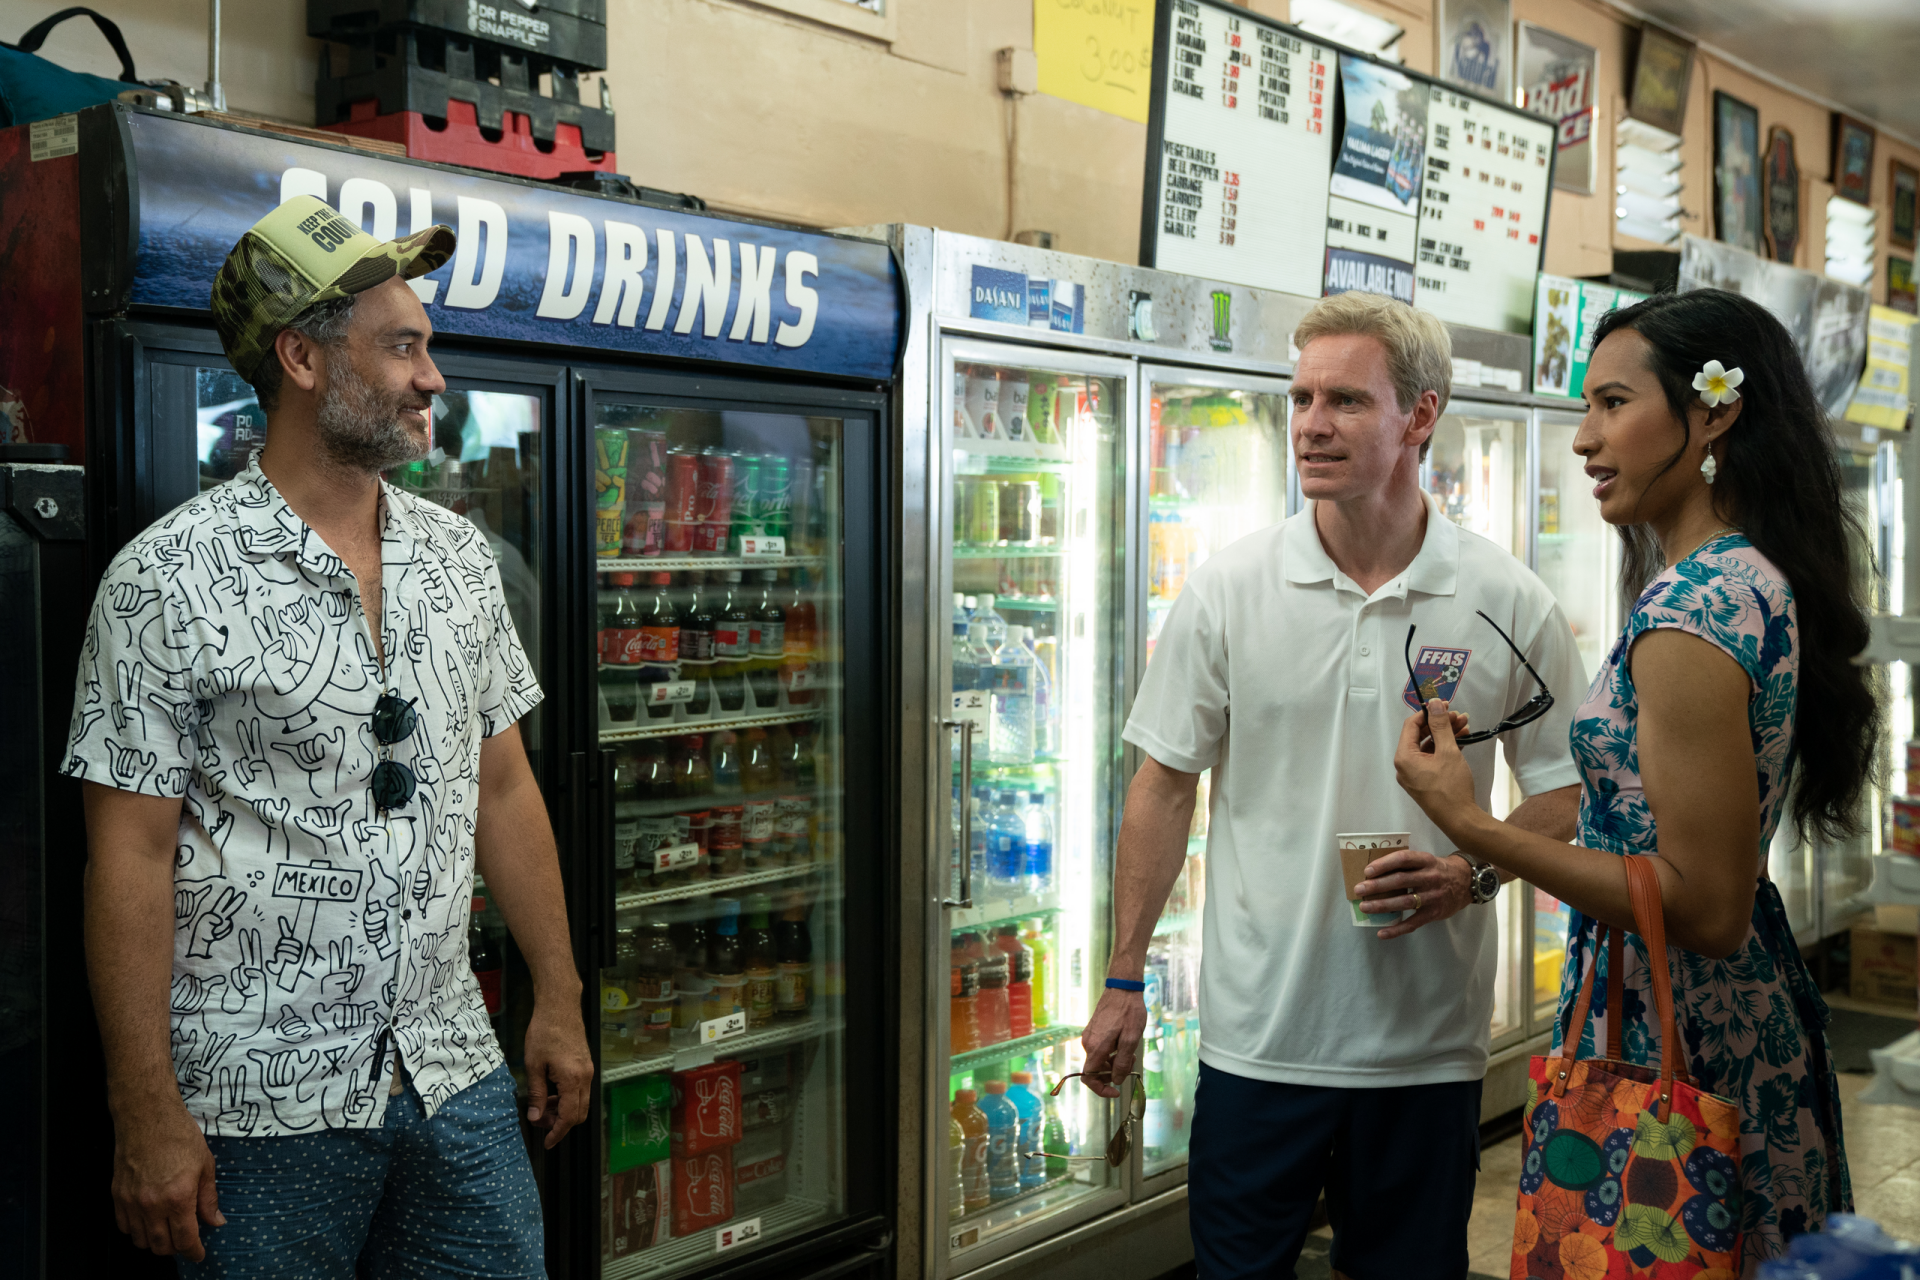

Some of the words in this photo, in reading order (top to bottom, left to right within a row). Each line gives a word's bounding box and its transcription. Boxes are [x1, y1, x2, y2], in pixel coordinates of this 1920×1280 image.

[478, 4, 497, 21] DR
[500, 10, 550, 35] PEPPER
[1178, 15, 1203, 36] APPLE
[478, 20, 538, 46] SNAPPLE
[1256, 26, 1301, 54] VEGETABLES
[1172, 78, 1204, 100] ORANGE
[1527, 64, 1588, 119] Bud
[1163, 140, 1215, 166] VEGETABLES
[1168, 157, 1187, 175] BELL
[1190, 163, 1219, 182] PEPPER
[1166, 173, 1203, 194] CABBAGE
[1165, 188, 1202, 209] CARROTS
[296, 215, 321, 236] KEEP
[1164, 204, 1197, 223] CELERY
[1164, 219, 1197, 239] GARLIC
[536, 211, 819, 347] DRINKS
[1329, 258, 1394, 297] AVAILABLE
[975, 285, 1020, 310] DASANI
[1420, 650, 1466, 666] FFAS
[278, 871, 353, 897] MEXICO
